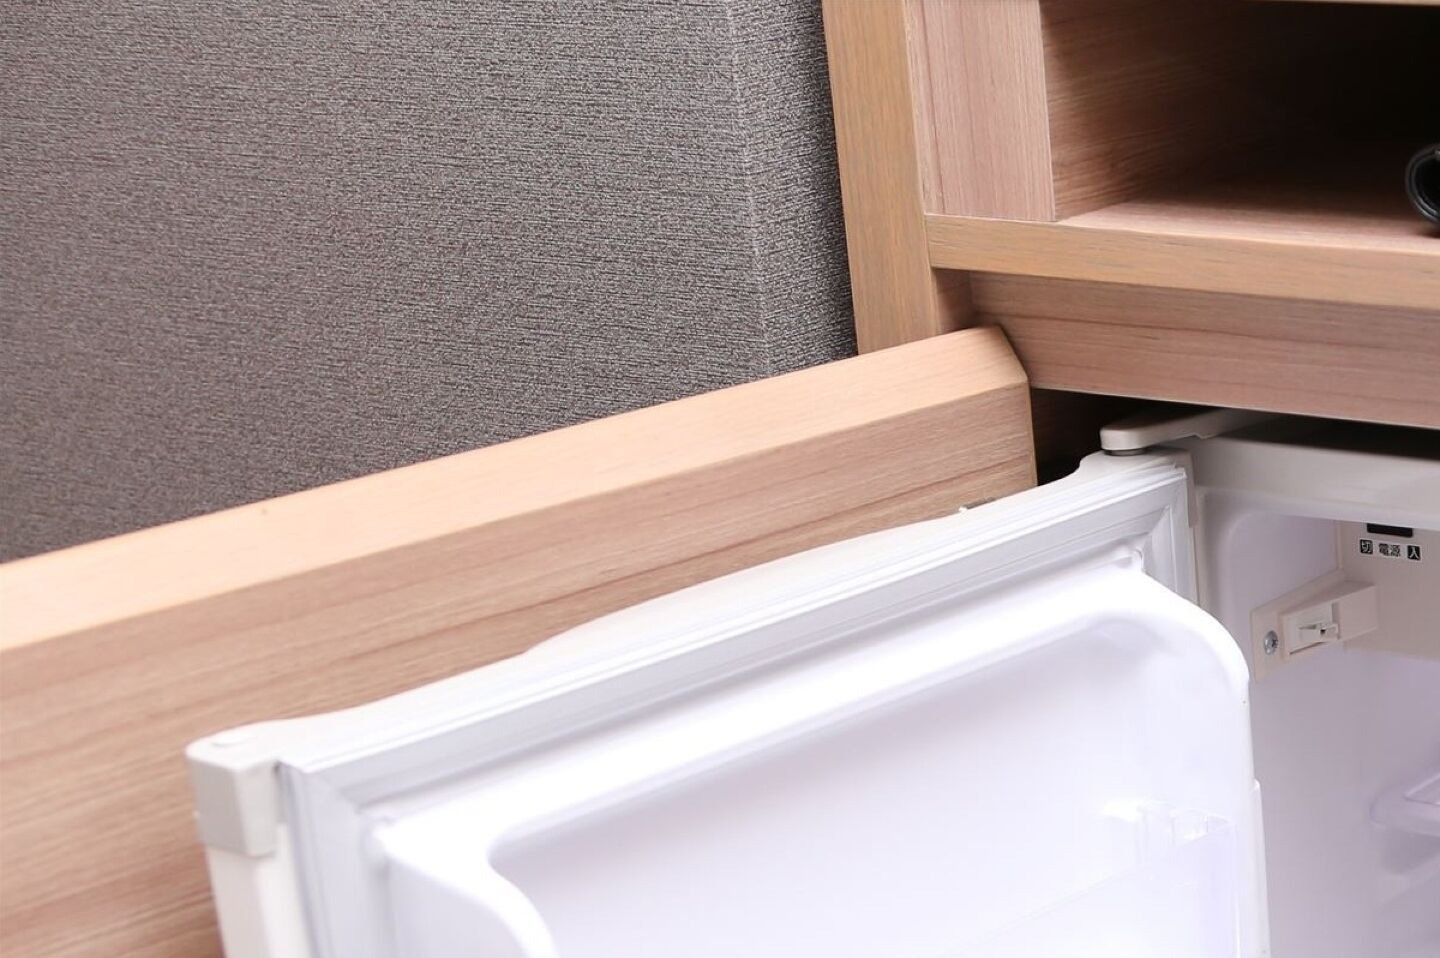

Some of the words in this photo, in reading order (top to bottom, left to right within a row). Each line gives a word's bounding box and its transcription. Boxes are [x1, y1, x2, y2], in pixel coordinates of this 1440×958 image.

[1360, 540, 1373, 554] 切
[1379, 543, 1400, 557] 電源
[1407, 545, 1420, 560] 入
